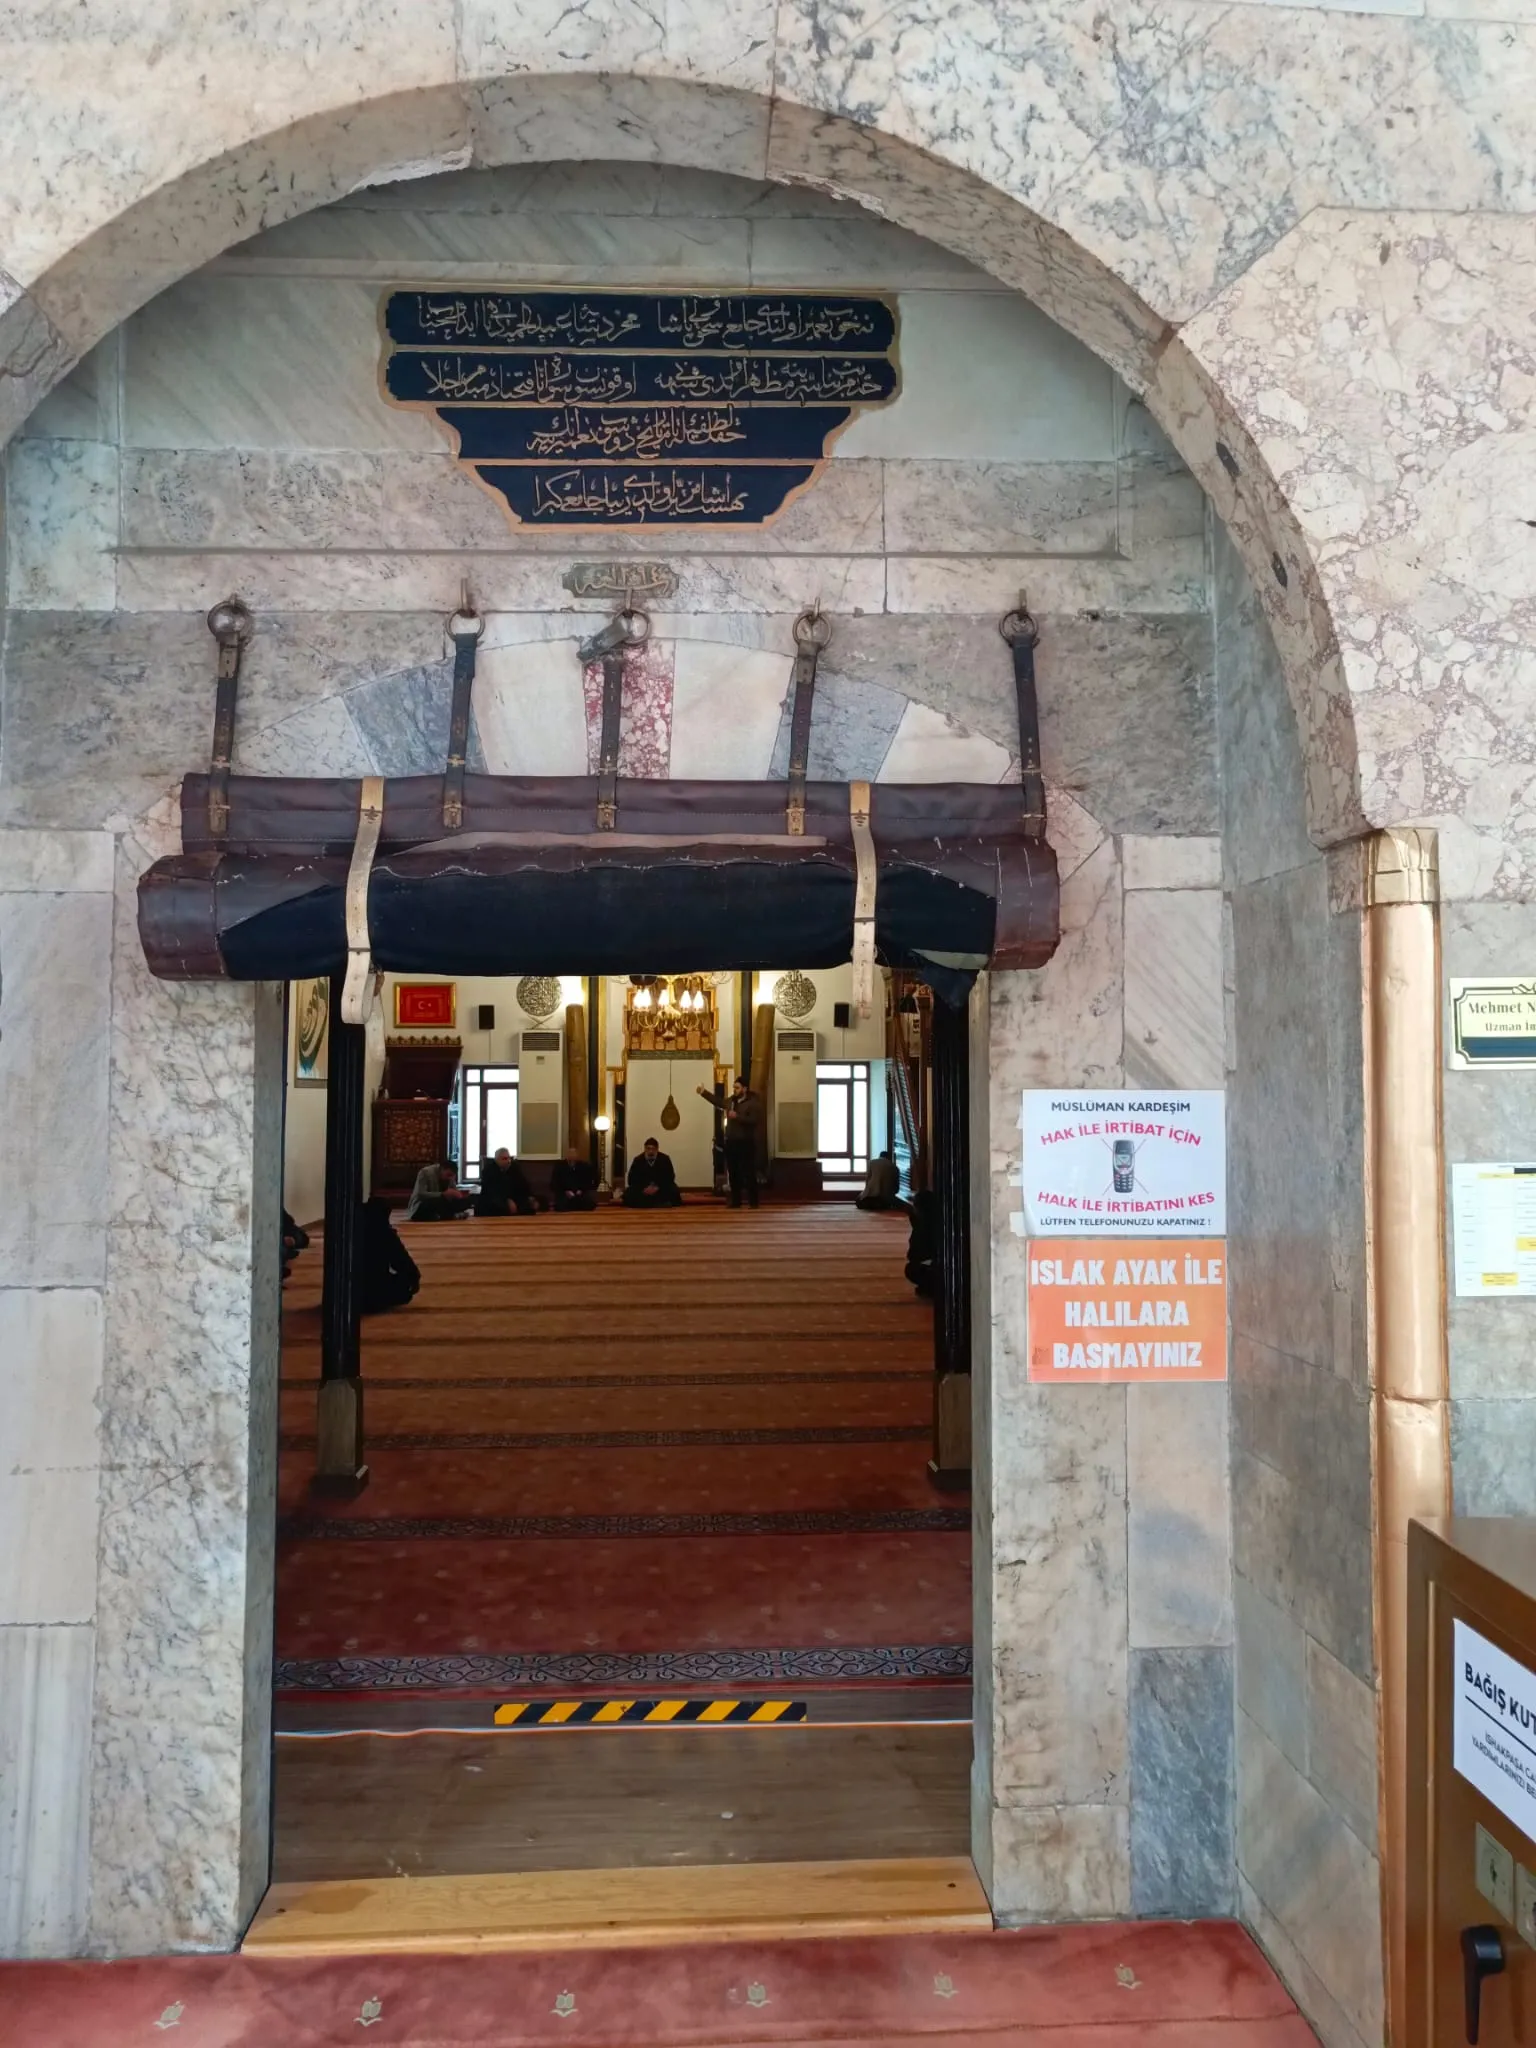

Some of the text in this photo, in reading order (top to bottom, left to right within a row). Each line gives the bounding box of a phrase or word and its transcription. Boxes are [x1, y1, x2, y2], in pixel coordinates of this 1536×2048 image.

[1468, 1001, 1523, 1014] Mehmet
[1051, 1100, 1191, 1115] MÜSLÜMAN KARDEŞİM
[1040, 1120, 1202, 1147] HAK İLE İRTİBAT İÇİN
[1037, 1191, 1216, 1213] HALK İLE İRTİBATINI KES
[1040, 1217, 1077, 1227] LÜTFEN
[1079, 1218, 1155, 1227] TELEFONUNUZU
[1156, 1218, 1206, 1227] KAPATINIZ
[1031, 1252, 1223, 1286] ISLAK AYAK İLE
[1065, 1300, 1190, 1327] HALILARA
[1053, 1341, 1203, 1369] BASMAYINIZ
[1464, 1661, 1507, 1715] BAĞIŞ
